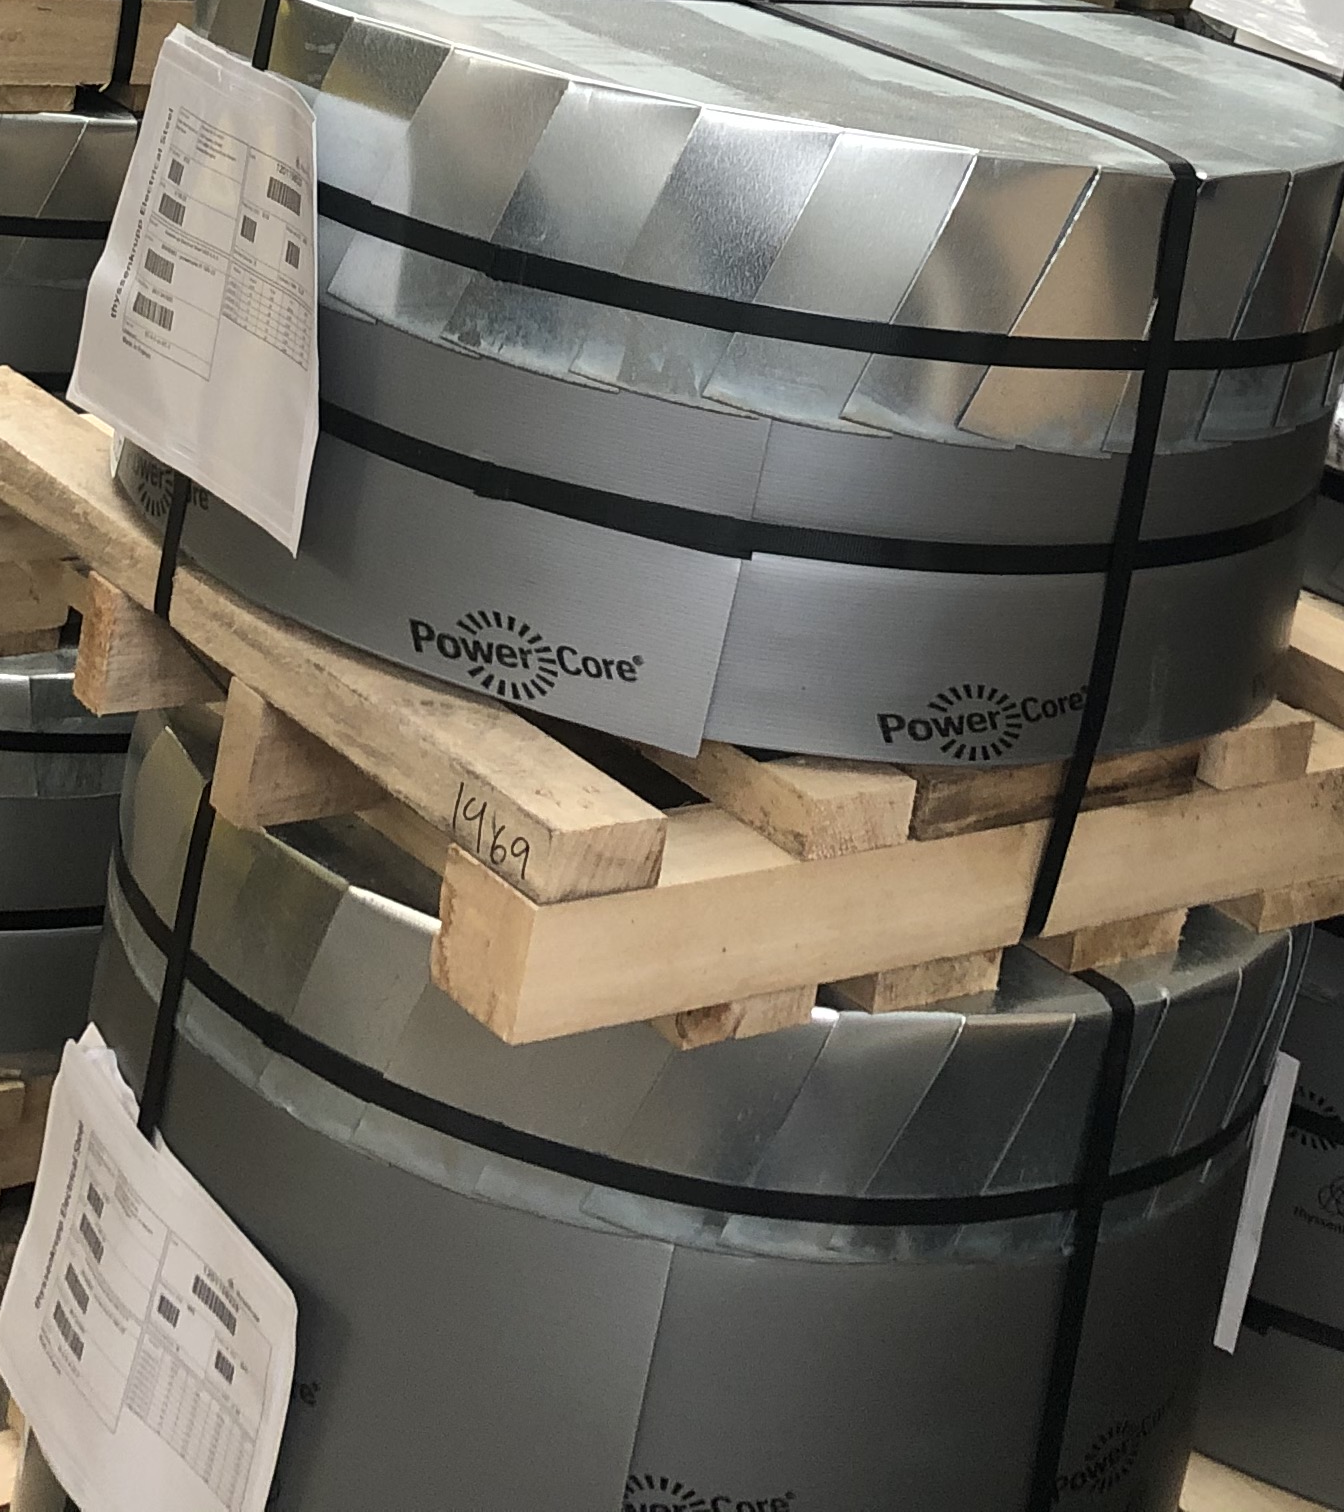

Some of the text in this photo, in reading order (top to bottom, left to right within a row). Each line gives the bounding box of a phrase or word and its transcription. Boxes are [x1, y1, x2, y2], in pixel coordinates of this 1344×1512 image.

[110, 107, 174, 320] thyssenkrupp Electrical Steel
[452, 781, 530, 880] 1969
